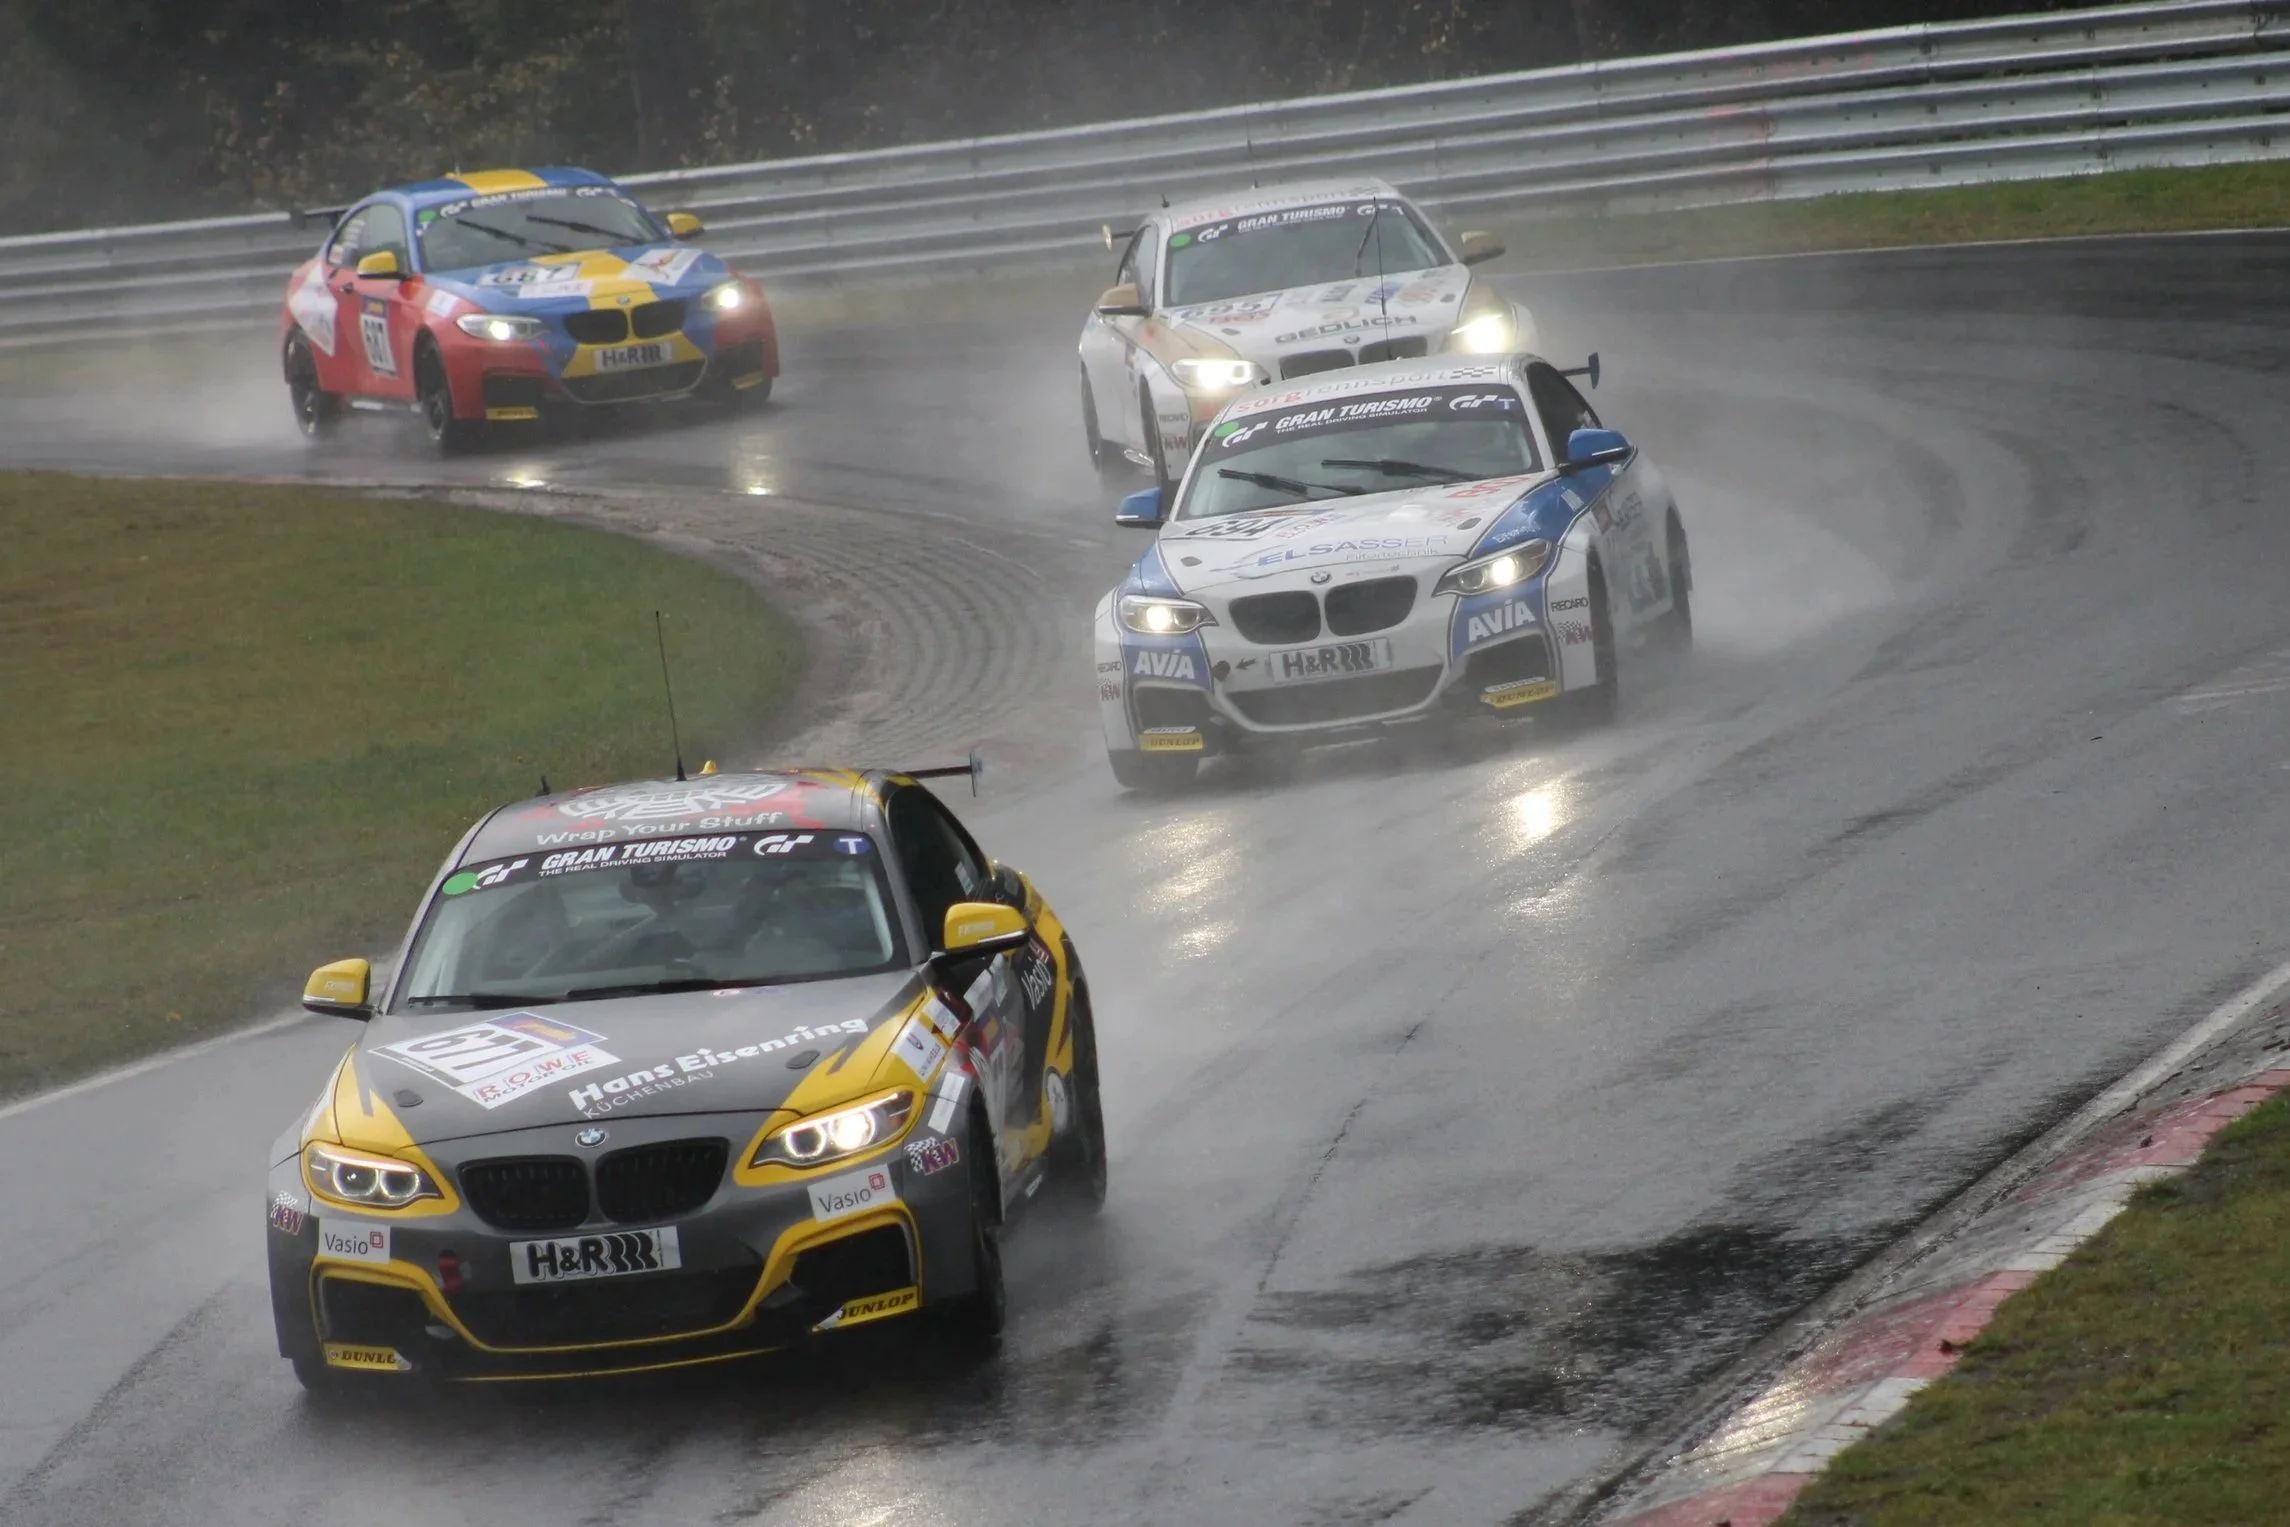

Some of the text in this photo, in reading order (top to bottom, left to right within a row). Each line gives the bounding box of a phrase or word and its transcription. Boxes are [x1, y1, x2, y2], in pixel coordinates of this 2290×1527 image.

[1237, 214, 1279, 230] GRAN
[1275, 314, 1418, 344] GEDLICH
[1275, 408, 1336, 430] GRAN
[1276, 407, 1428, 434] THE REAL DRIVING SIMULATOR
[1282, 647, 1340, 680] H&R
[536, 811, 784, 847] Wrap Your Stuff
[541, 836, 737, 870] GRAN TURISMO
[838, 837, 863, 855] T
[538, 850, 727, 878] THE REAL DRIVING SIMULATOR
[568, 1063, 674, 1111] Hans
[674, 1018, 869, 1074] Eisenring
[583, 1069, 715, 1120] KÜCHENBAU
[818, 1187, 872, 1214] Vasio
[324, 1232, 369, 1255] Vasio
[526, 1237, 609, 1279] H&R
